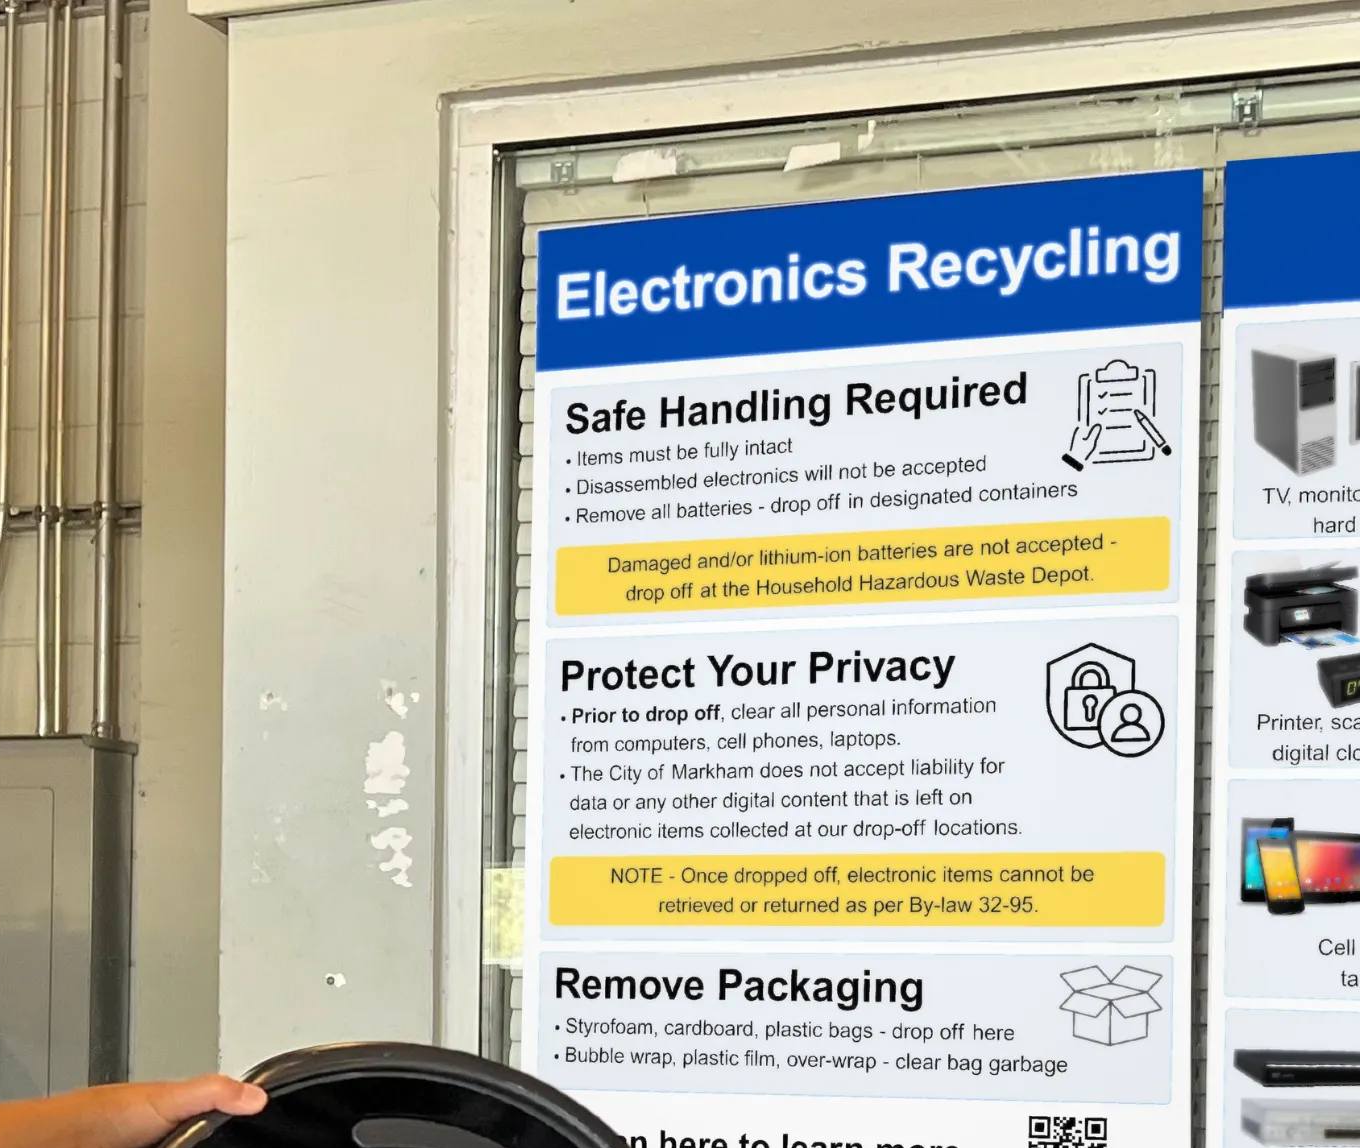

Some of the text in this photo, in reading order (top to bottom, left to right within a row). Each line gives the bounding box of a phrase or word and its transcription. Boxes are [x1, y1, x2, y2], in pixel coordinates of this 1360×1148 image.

[558, 226, 1179, 319] Electronics Recycling
[566, 371, 1027, 434] Safe Handling Required
[578, 437, 792, 466] Items must fully intact
[577, 454, 986, 494] Disassembled electronics will accepted
[576, 482, 1078, 523] Remove batteries drop designated containers
[1262, 487, 1291, 505] TV,
[1314, 516, 1356, 533] hard
[608, 533, 1103, 575] Damaged and/or lithium-ion batteries accepted
[626, 565, 1093, 604] drop Household Hazardous Waste Depot.
[561, 651, 956, 692] Protect Your Privacy
[572, 697, 996, 725] Prior drop off, clear personal information
[1257, 713, 1322, 730] Printer,
[571, 730, 900, 754] from computers, cell phones, laptops.
[1272, 744, 1329, 765] digital
[571, 758, 974, 785] The City Markham does accept liability
[570, 788, 943, 813] data any other digital content that left
[569, 818, 1021, 840] electronic items collected drop-off locations.
[611, 866, 1064, 887] NOTE Once dropped off, electronic items cannot
[659, 896, 1038, 916] retrieved returned By-law 32-95.
[1318, 938, 1355, 956] Cell
[556, 967, 922, 1012] Remove Packaging
[566, 1017, 1014, 1043] Styrofoam, cardboard, plastic bags drop here
[565, 1046, 1068, 1077] Bubble wrap, plastic film, over-wrap clear bag garbage
